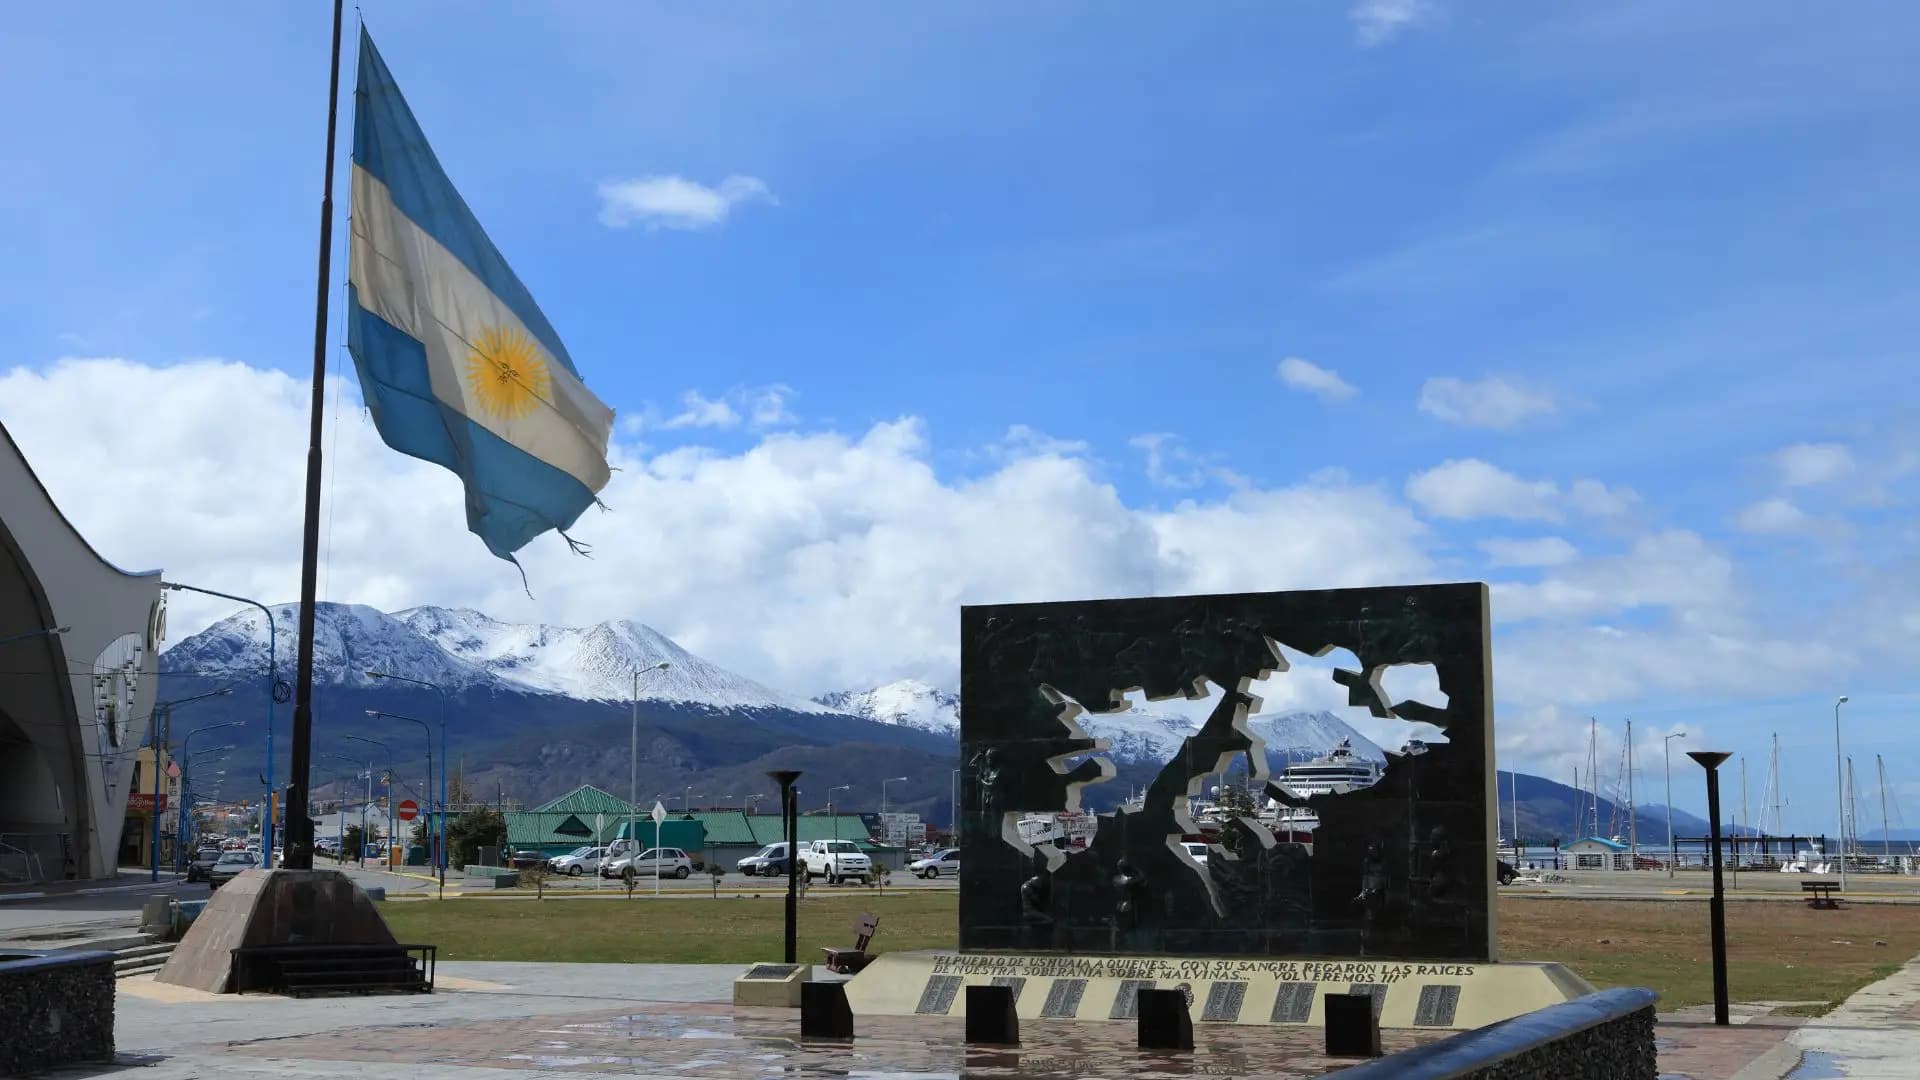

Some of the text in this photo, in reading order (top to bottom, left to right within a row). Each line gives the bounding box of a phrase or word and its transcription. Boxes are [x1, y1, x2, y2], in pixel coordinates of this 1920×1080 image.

[931, 964, 949, 974] DE
[953, 965, 1016, 976] NUESTRA
[1107, 968, 1155, 979] SOBRE
[952, 955, 1005, 967] PUEBLO
[1007, 957, 1025, 967] DE
[1030, 957, 1091, 969] USHUAIA
[1093, 959, 1104, 969] A
[1181, 961, 1210, 971] CON
[1214, 961, 1234, 971] SU
[1237, 961, 1297, 972] SANGRE
[1303, 962, 1376, 973] REGARON
[1381, 964, 1412, 974] LAS
